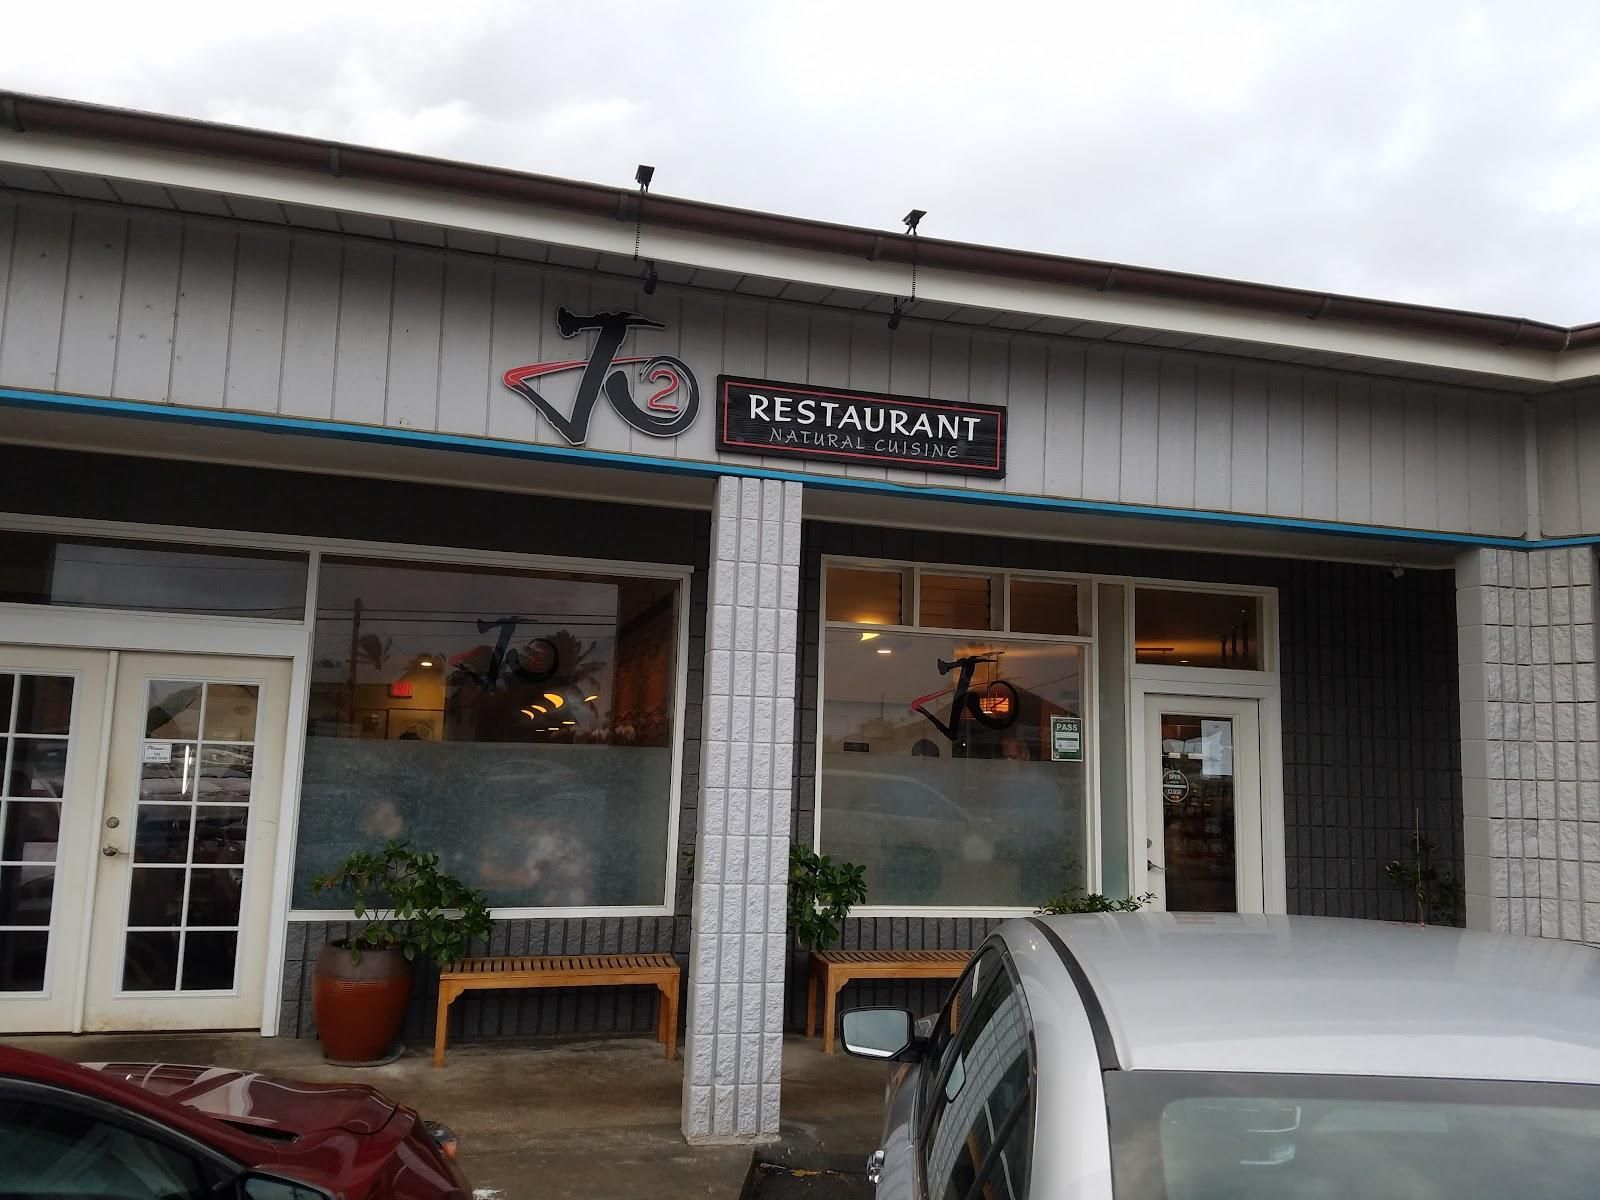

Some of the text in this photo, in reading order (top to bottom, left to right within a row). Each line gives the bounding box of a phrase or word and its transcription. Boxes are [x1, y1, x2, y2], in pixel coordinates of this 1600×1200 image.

[748, 393, 982, 442] RESTAURANT
[768, 427, 960, 458] NATURAL CUISINE
[1056, 723, 1078, 731] PASS
